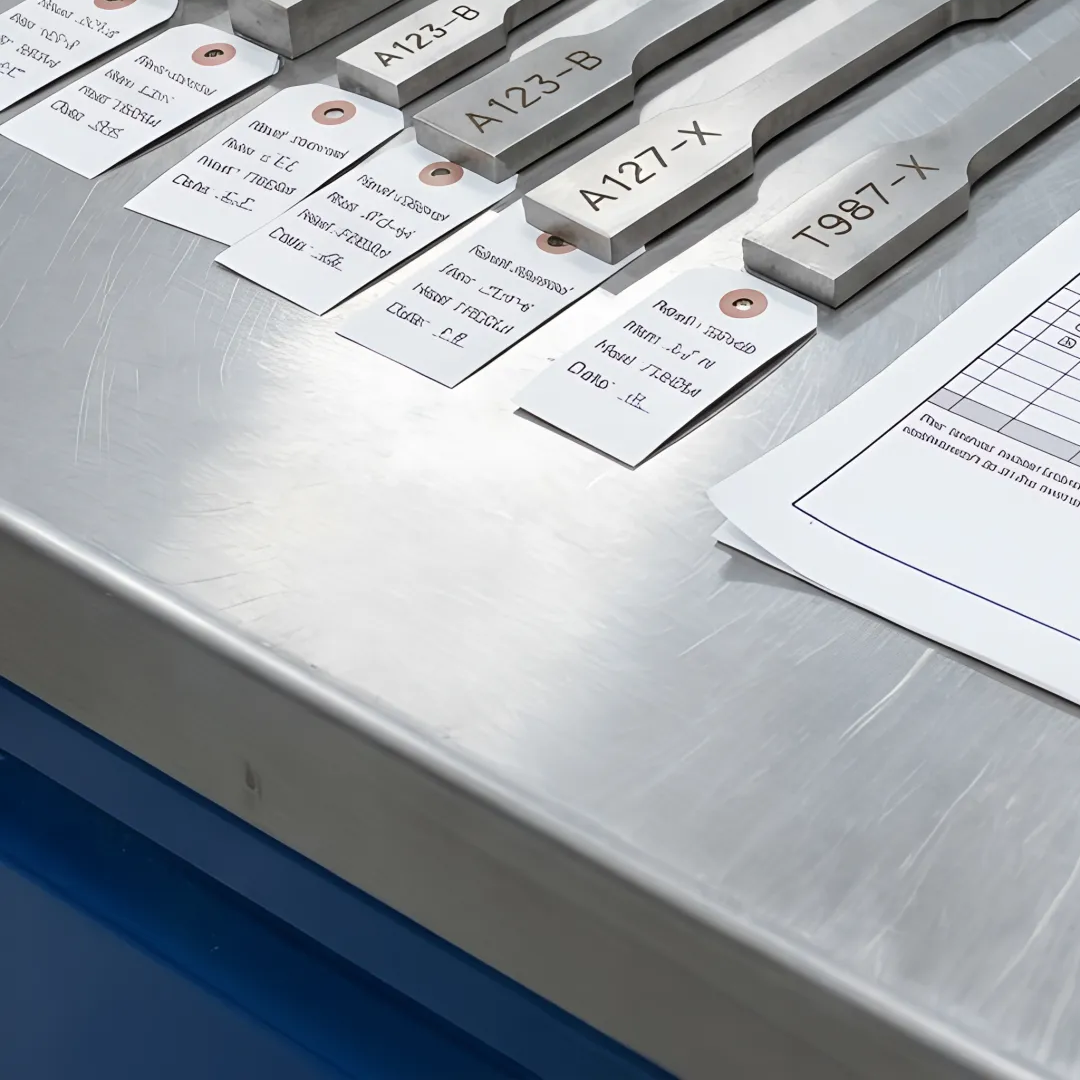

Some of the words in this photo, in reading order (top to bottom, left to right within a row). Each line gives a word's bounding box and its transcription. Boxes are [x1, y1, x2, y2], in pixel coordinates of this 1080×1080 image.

[374, 5, 480, 67] A123-B
[465, 50, 603, 134] A123-B
[579, 120, 722, 212] A127-X
[792, 154, 940, 247] T987-X
